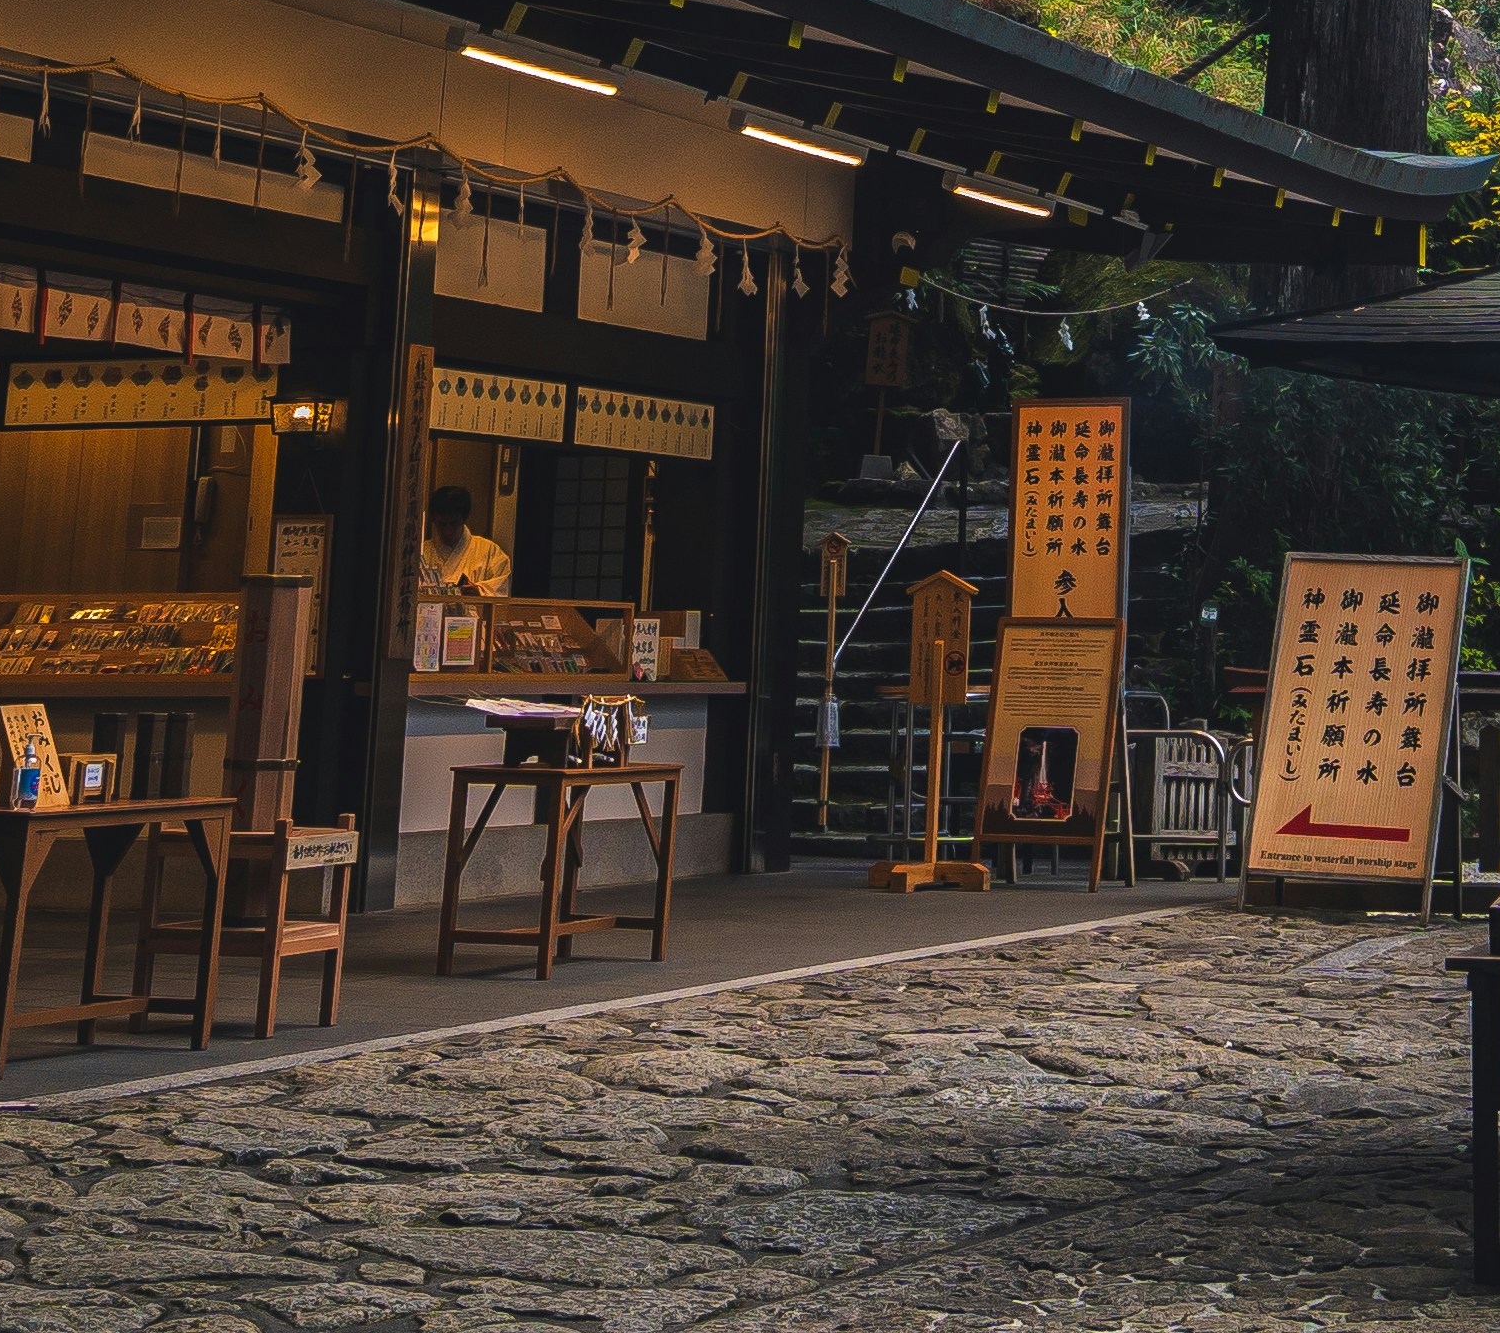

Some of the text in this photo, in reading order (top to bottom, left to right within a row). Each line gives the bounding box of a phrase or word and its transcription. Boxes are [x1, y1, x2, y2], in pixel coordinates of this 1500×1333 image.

[1021, 420, 1043, 557] 神霊石(みたまいし)
[1045, 419, 1067, 556] 御瀧本祈願所
[1070, 420, 1092, 556] 延命長寿の水
[1095, 419, 1116, 556] 御瀧拝所舞台
[32, 710, 62, 794] おみくじ
[1277, 586, 1326, 782] 神霊石(みたまいし)
[1316, 588, 1364, 784] 御瀧本祈願所
[1355, 590, 1402, 786] 延命長寿の水
[1395, 591, 1440, 788] 御瀧拝所舞台
[1260, 850, 1418, 870] Entrance to waterfall worship stage
